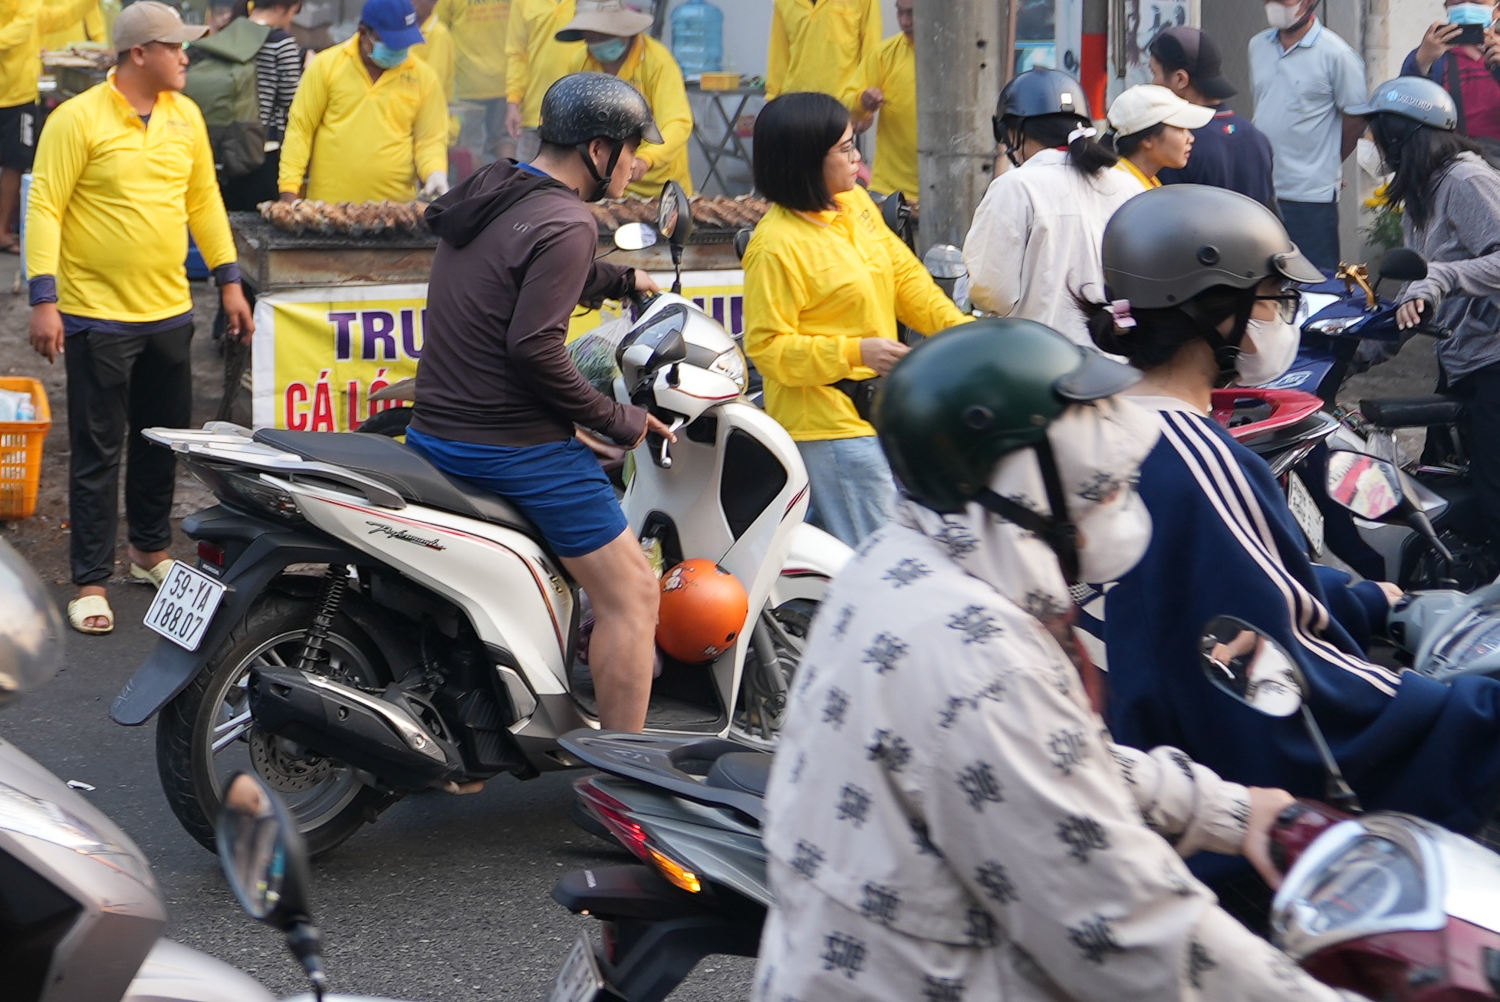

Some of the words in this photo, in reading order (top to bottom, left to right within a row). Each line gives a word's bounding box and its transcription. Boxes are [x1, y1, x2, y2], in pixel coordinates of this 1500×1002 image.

[328, 310, 428, 360] TRU
[286, 371, 335, 432] CÁ
[169, 569, 213, 613] 59-YA
[153, 597, 204, 642] 188.07
